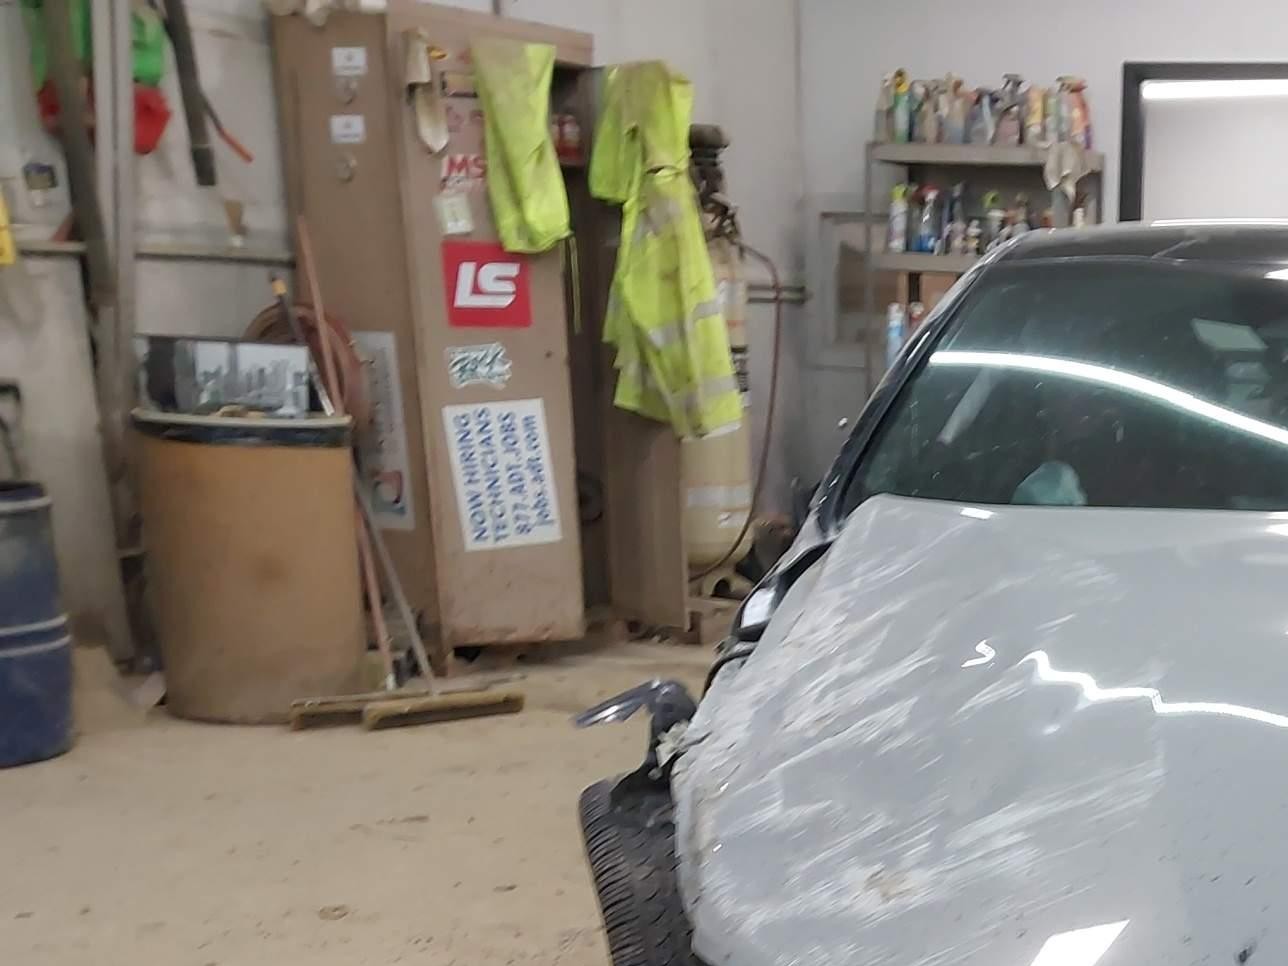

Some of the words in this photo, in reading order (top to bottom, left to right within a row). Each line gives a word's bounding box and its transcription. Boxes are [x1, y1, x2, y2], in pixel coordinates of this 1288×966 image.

[454, 261, 521, 308] LS
[453, 412, 481, 486] HIRING
[473, 406, 511, 542] TECHNICIANS
[466, 490, 490, 542] NOW
